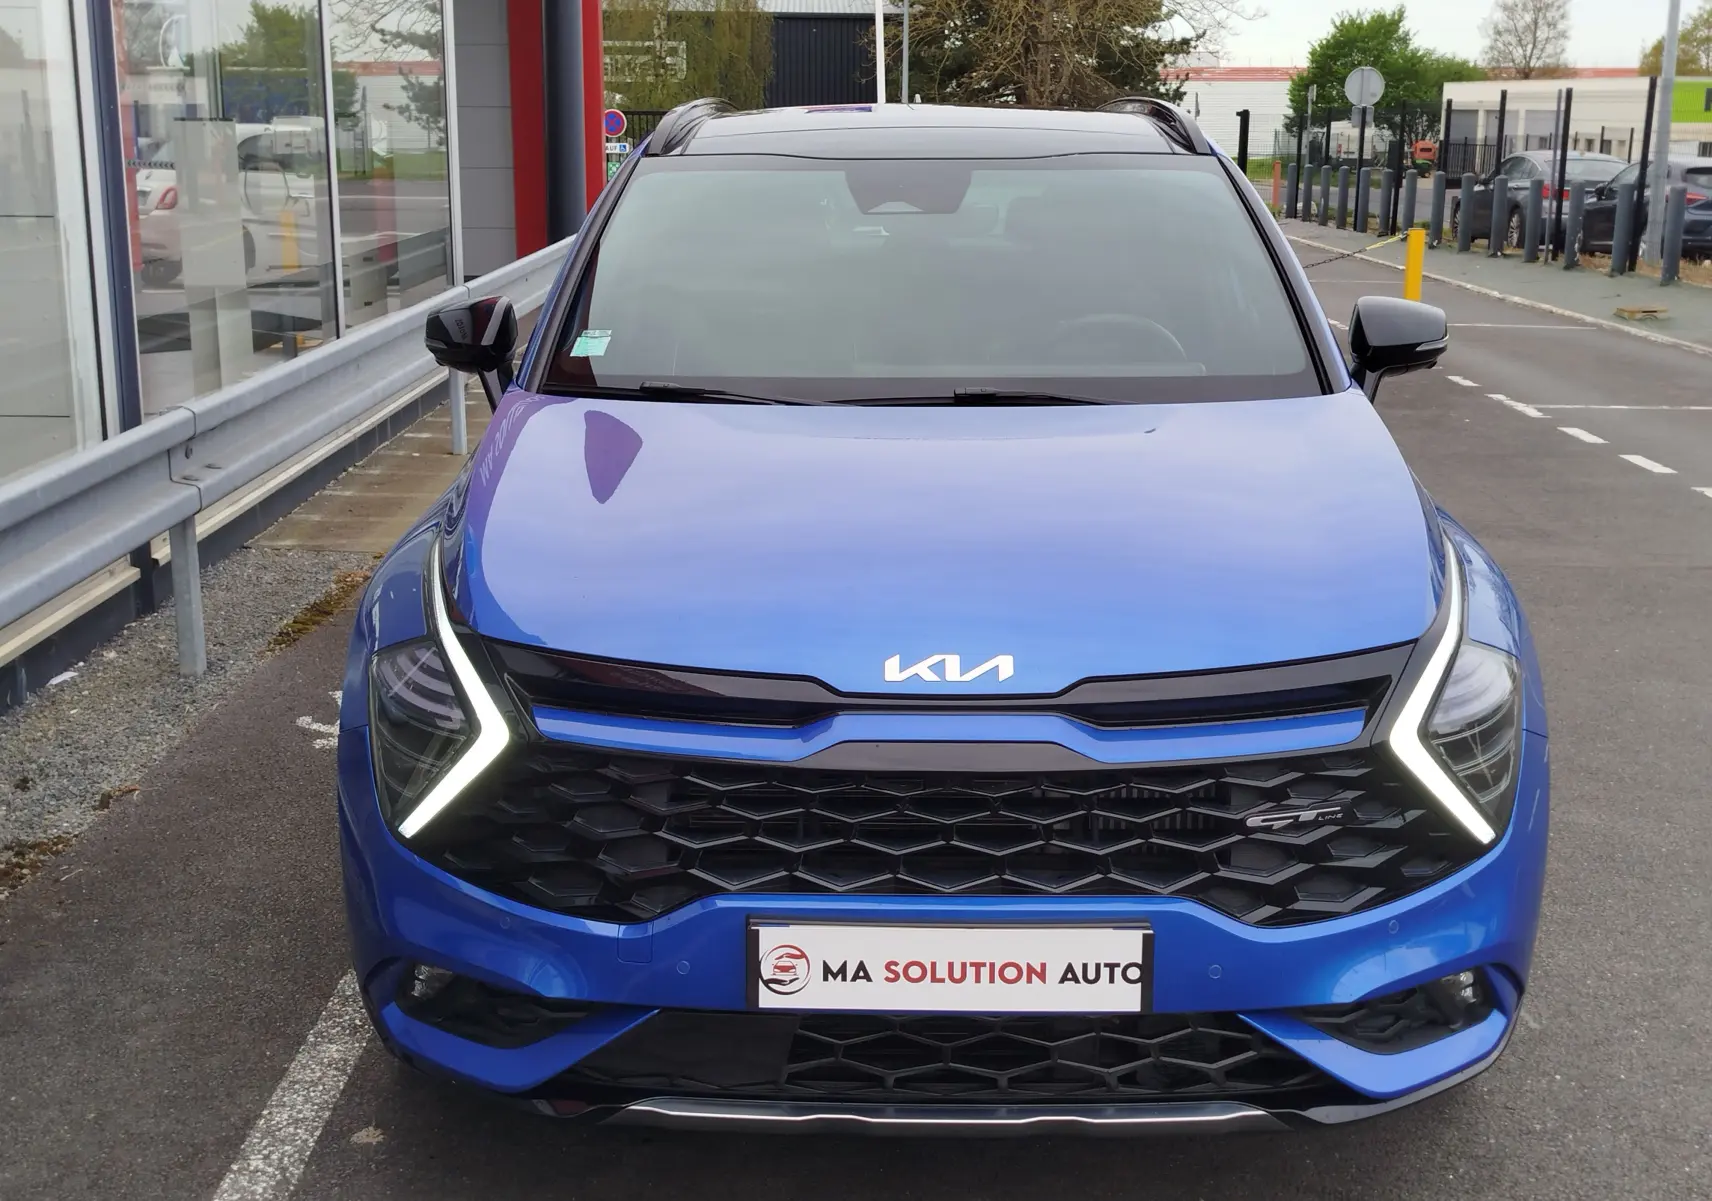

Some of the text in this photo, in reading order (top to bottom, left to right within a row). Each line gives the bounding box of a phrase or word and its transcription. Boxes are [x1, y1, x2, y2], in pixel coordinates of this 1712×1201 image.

[884, 654, 1015, 682] KIA
[1246, 806, 1343, 830] GT LINE
[822, 960, 1143, 985] MA SOLUTION AUTO
